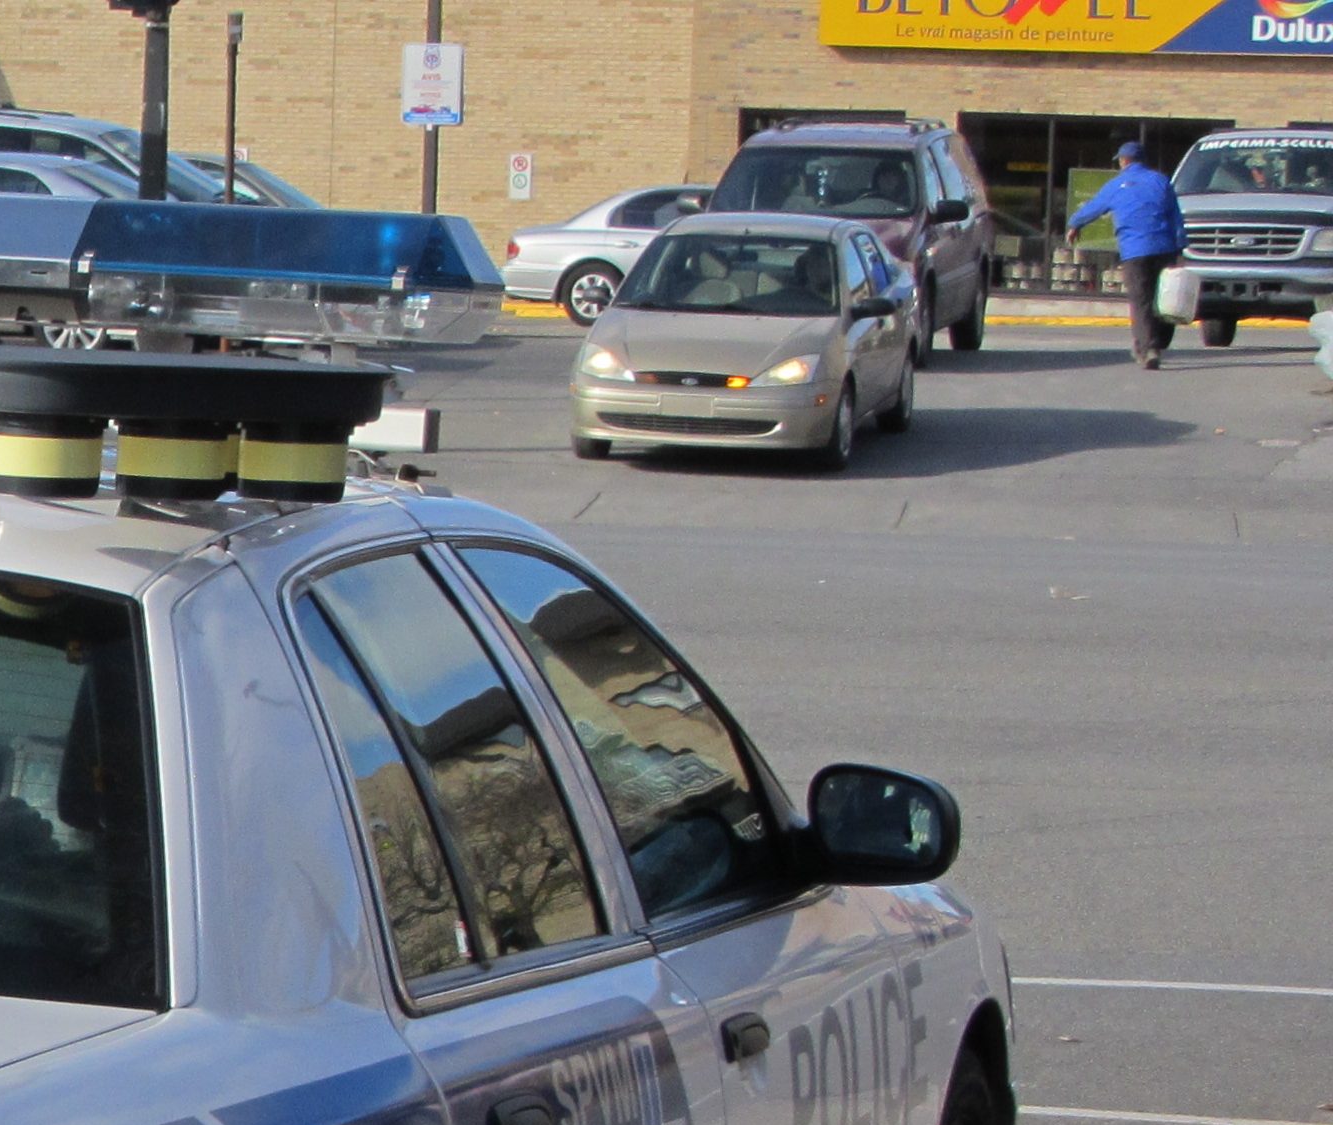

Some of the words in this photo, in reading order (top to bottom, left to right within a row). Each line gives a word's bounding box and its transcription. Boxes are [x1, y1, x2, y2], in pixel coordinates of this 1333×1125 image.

[896, 24, 915, 37] Le
[920, 25, 945, 38] vrai
[949, 28, 1014, 42] magasin
[1019, 26, 1040, 40] de
[1045, 27, 1114, 43] peinture
